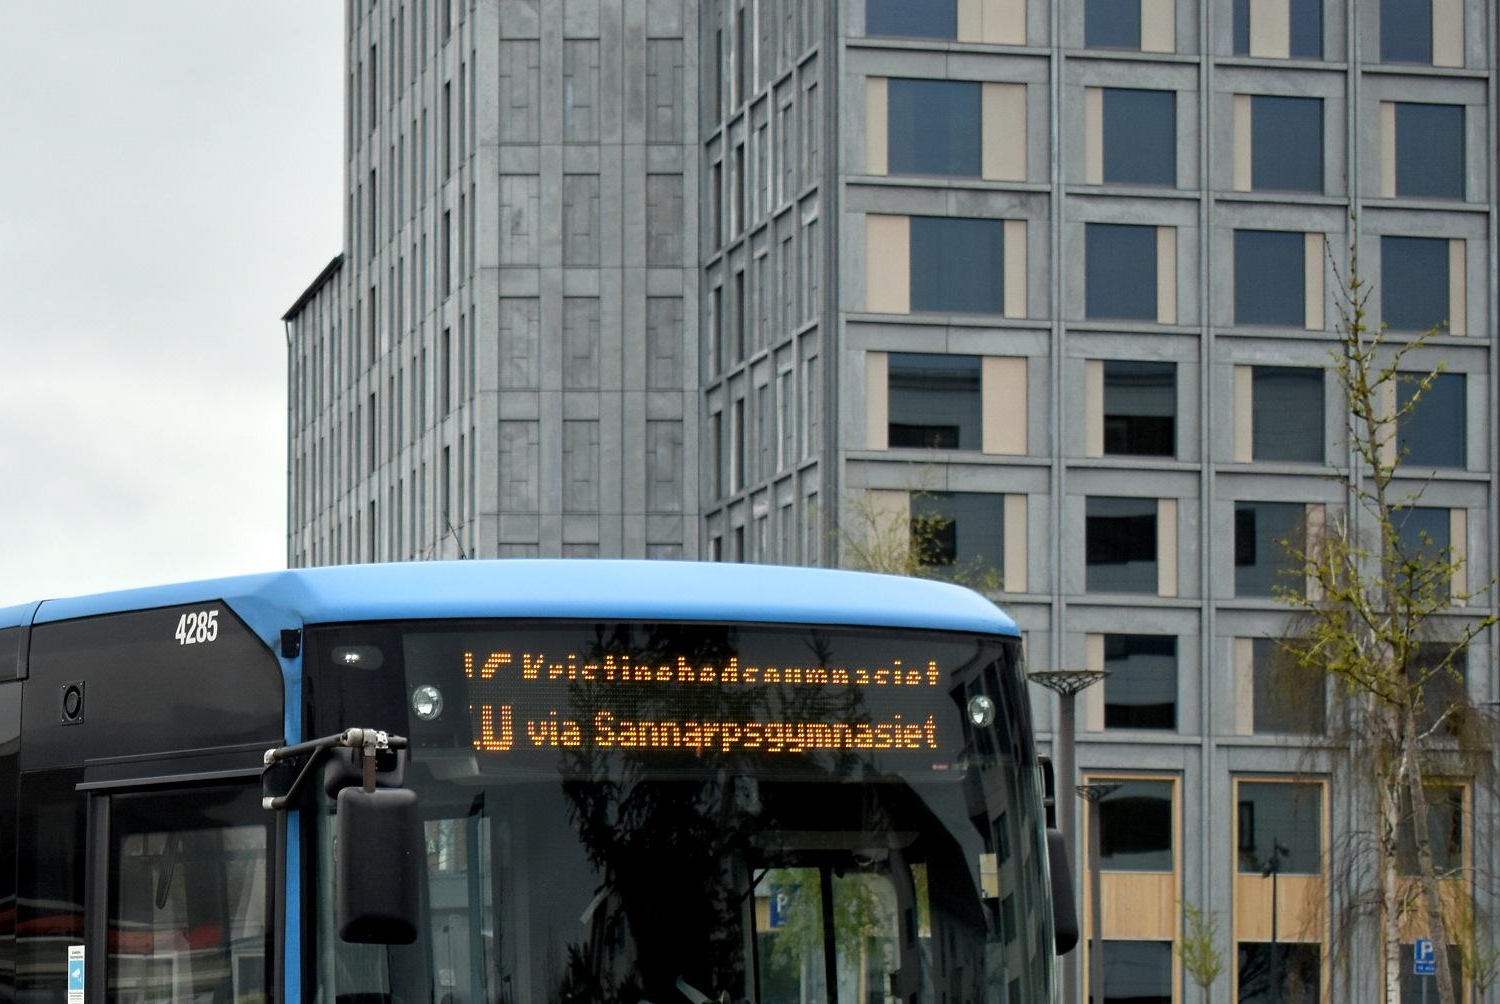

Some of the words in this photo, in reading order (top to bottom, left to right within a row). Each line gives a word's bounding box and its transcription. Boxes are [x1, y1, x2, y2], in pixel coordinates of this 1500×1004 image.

[175, 610, 219, 645] 4285
[527, 711, 581, 746] via
[594, 710, 938, 752] Sannarpsgymnasiet
[1421, 941, 1433, 960] P
